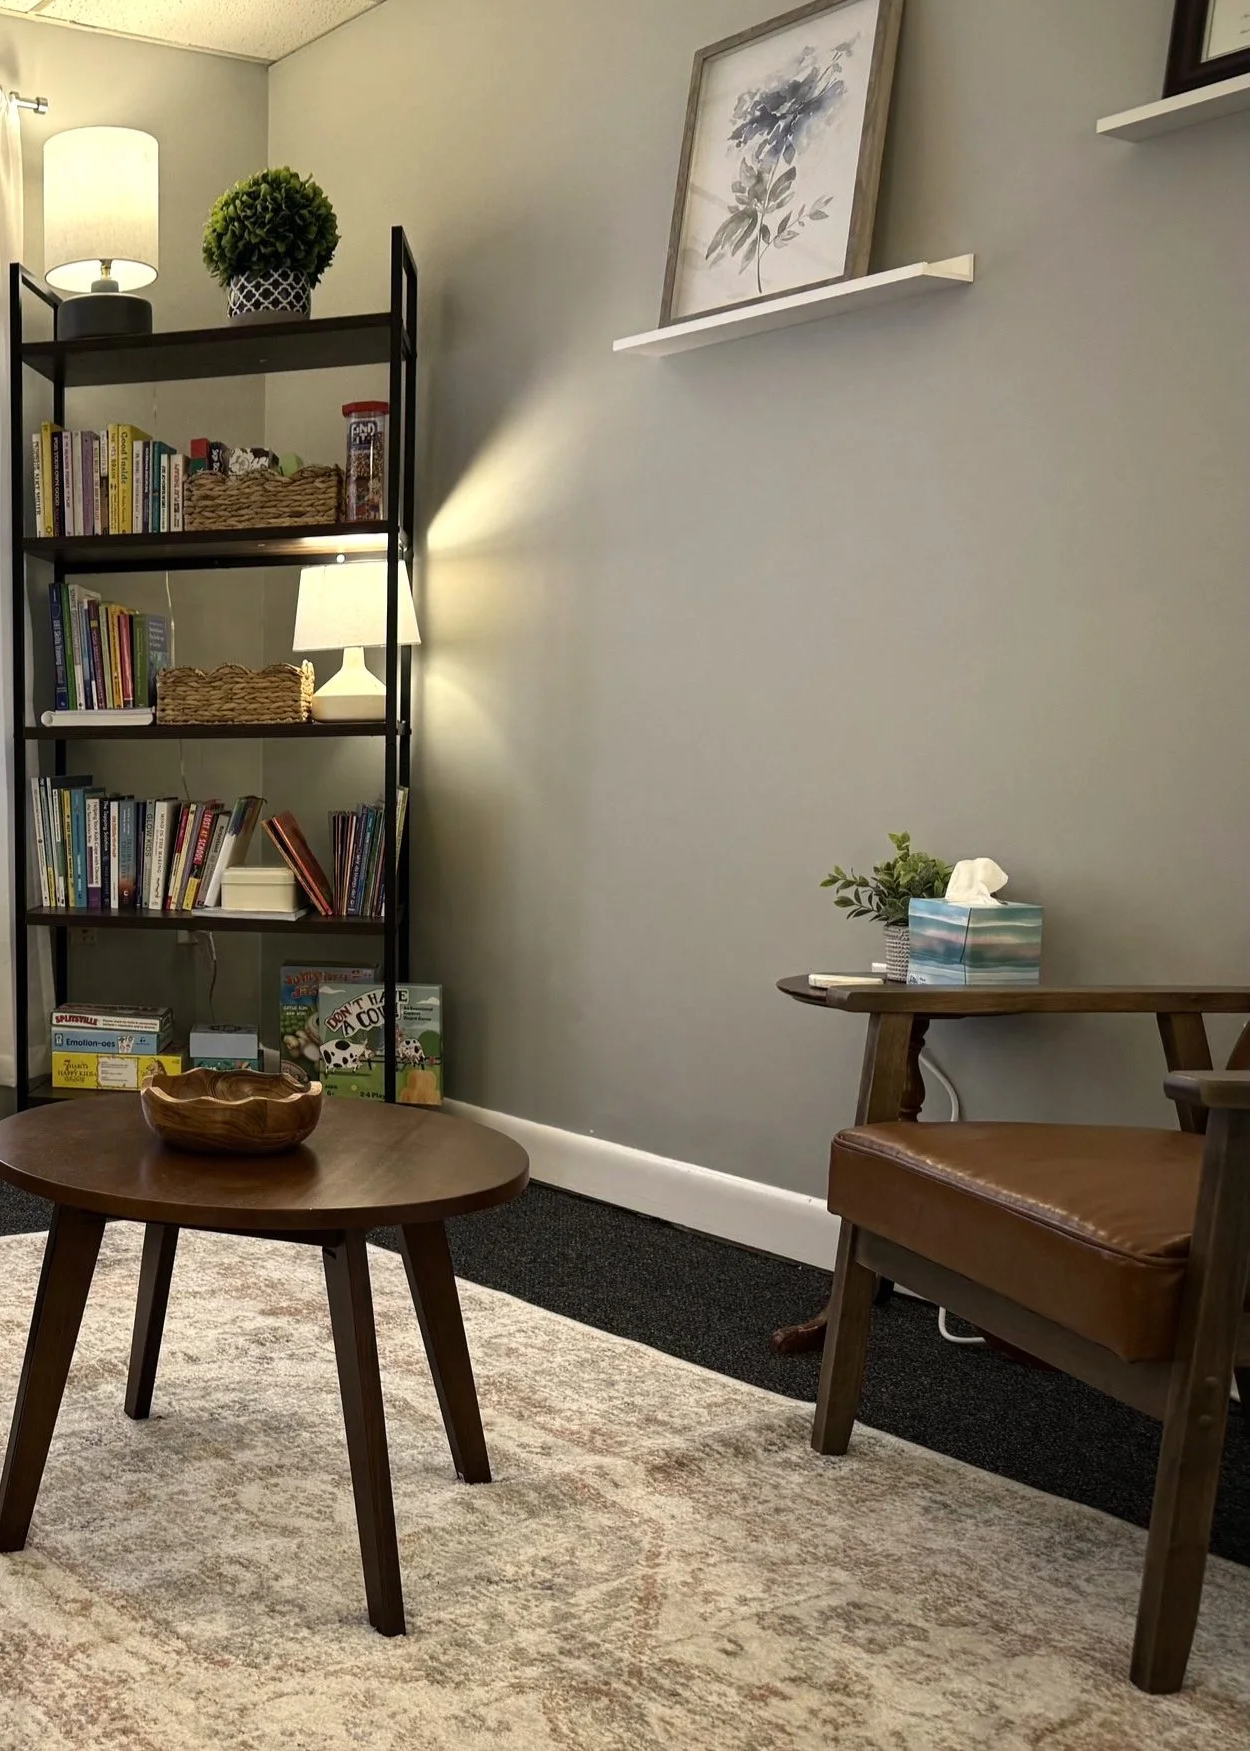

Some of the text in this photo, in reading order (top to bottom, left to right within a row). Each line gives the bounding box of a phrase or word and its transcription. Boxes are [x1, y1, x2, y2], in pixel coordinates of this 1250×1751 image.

[120, 431, 129, 485] Good Inside
[53, 631, 62, 645] Skills
[54, 644, 63, 666] Training
[194, 813, 213, 862] LOST AT SCHOOL
[326, 989, 408, 1031] DON'T HE
[55, 1014, 98, 1026] SPLITSVILLE
[343, 1019, 355, 1035] A
[66, 1038, 116, 1048] Emotion-oes
